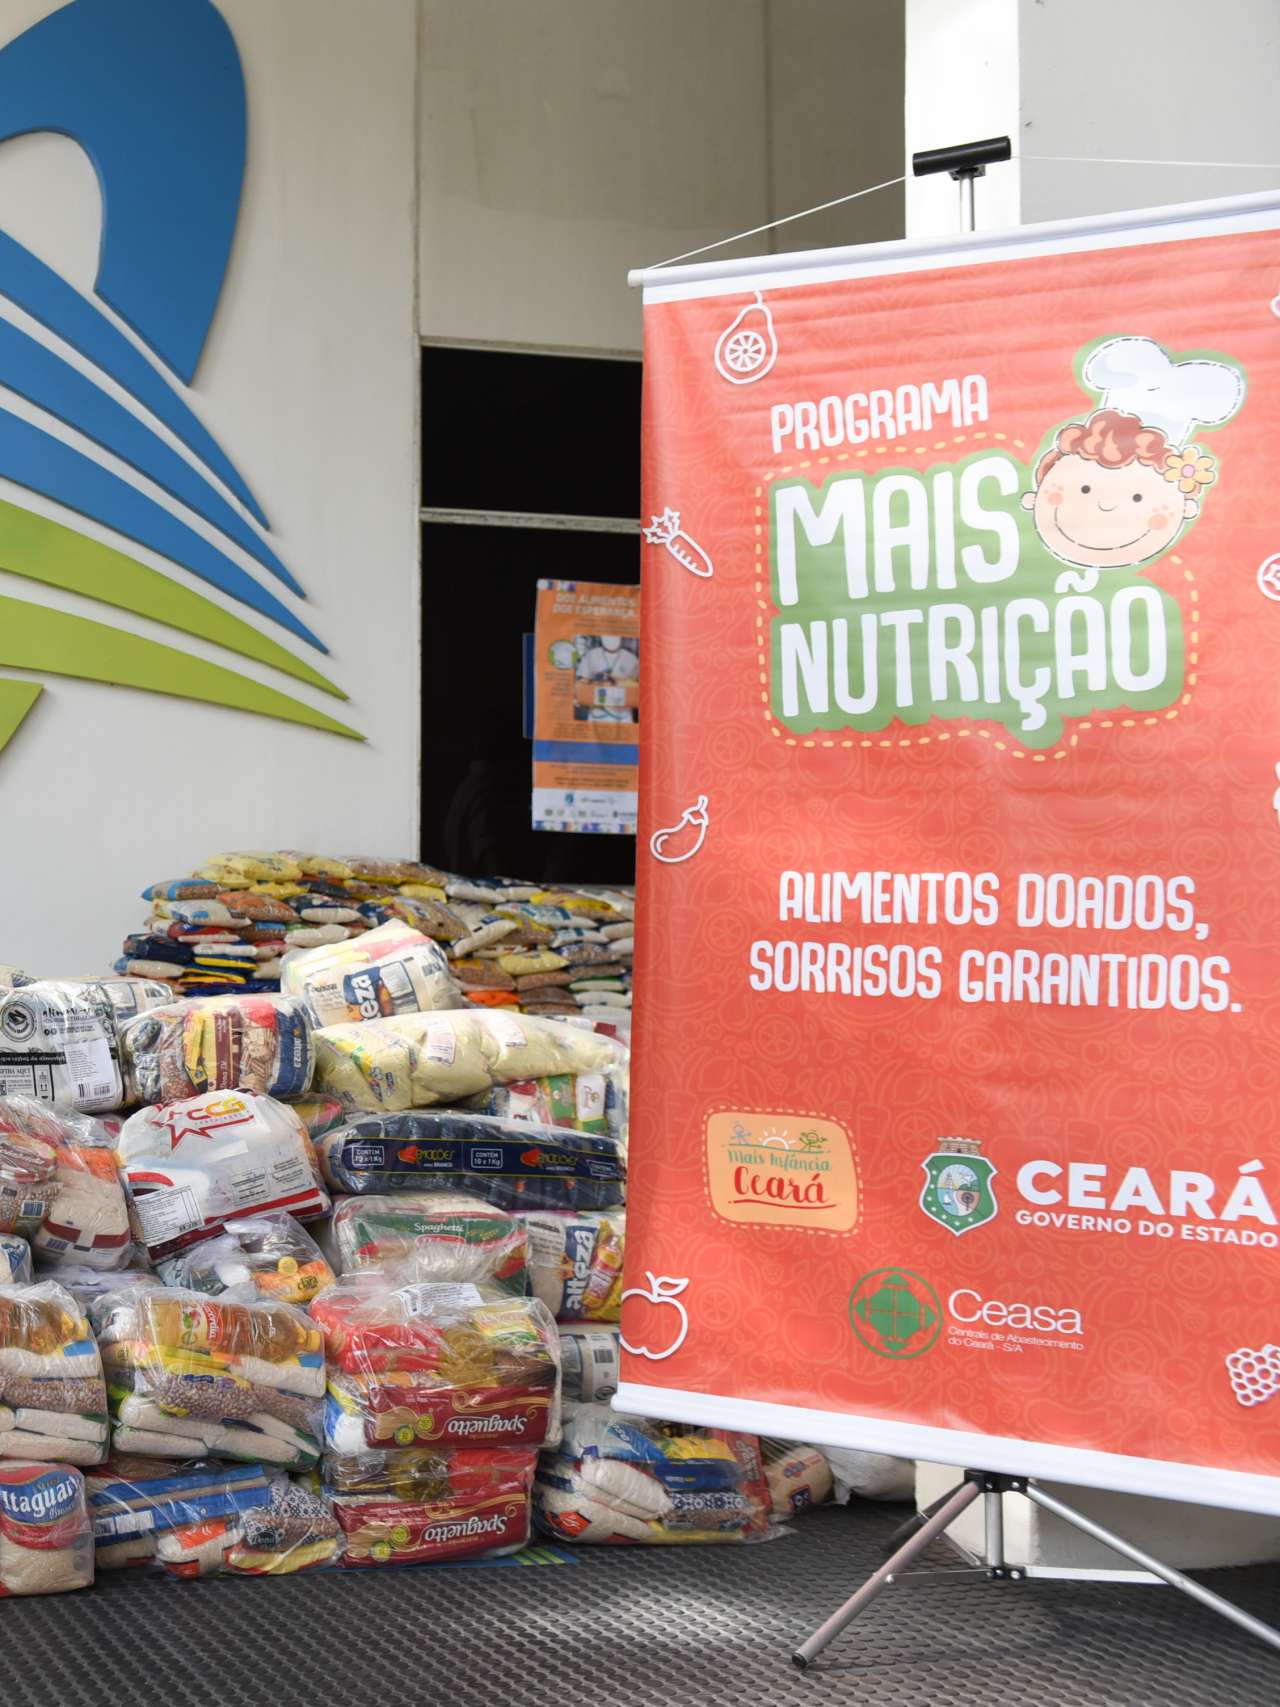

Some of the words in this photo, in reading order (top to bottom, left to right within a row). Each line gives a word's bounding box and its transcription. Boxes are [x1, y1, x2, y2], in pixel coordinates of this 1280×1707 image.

[771, 374, 988, 454] PROGRAMA
[775, 457, 1020, 606] MAIS
[780, 569, 1167, 731] NUTRIÇÃO
[779, 870, 1000, 926] ALIMENTOS
[1017, 873, 1209, 940] DOADOS,
[749, 940, 942, 999] SORRISOS
[959, 950, 1242, 1013] GARANTIDOS.
[728, 1149, 764, 1165] Mais
[770, 1150, 832, 1172] Infância
[734, 1166, 829, 1204] Ceará
[1016, 1159, 1279, 1226] CEARÁ
[1015, 1209, 1131, 1235] GOVERNO
[1139, 1220, 1174, 1239] DO
[1181, 1224, 1279, 1249] ESTADO
[948, 1288, 1084, 1335] Ceasa
[948, 1326, 989, 1340] Centrais
[991, 1331, 1005, 1342] de
[1007, 1333, 1084, 1351] Abastecimento
[948, 1337, 961, 1346] do
[1002, 1342, 1024, 1353] S/A
[448, 1413, 528, 1436] Spaguetto
[4, 1475, 81, 1518] Itaguary
[424, 1515, 507, 1544] Spaguetto
